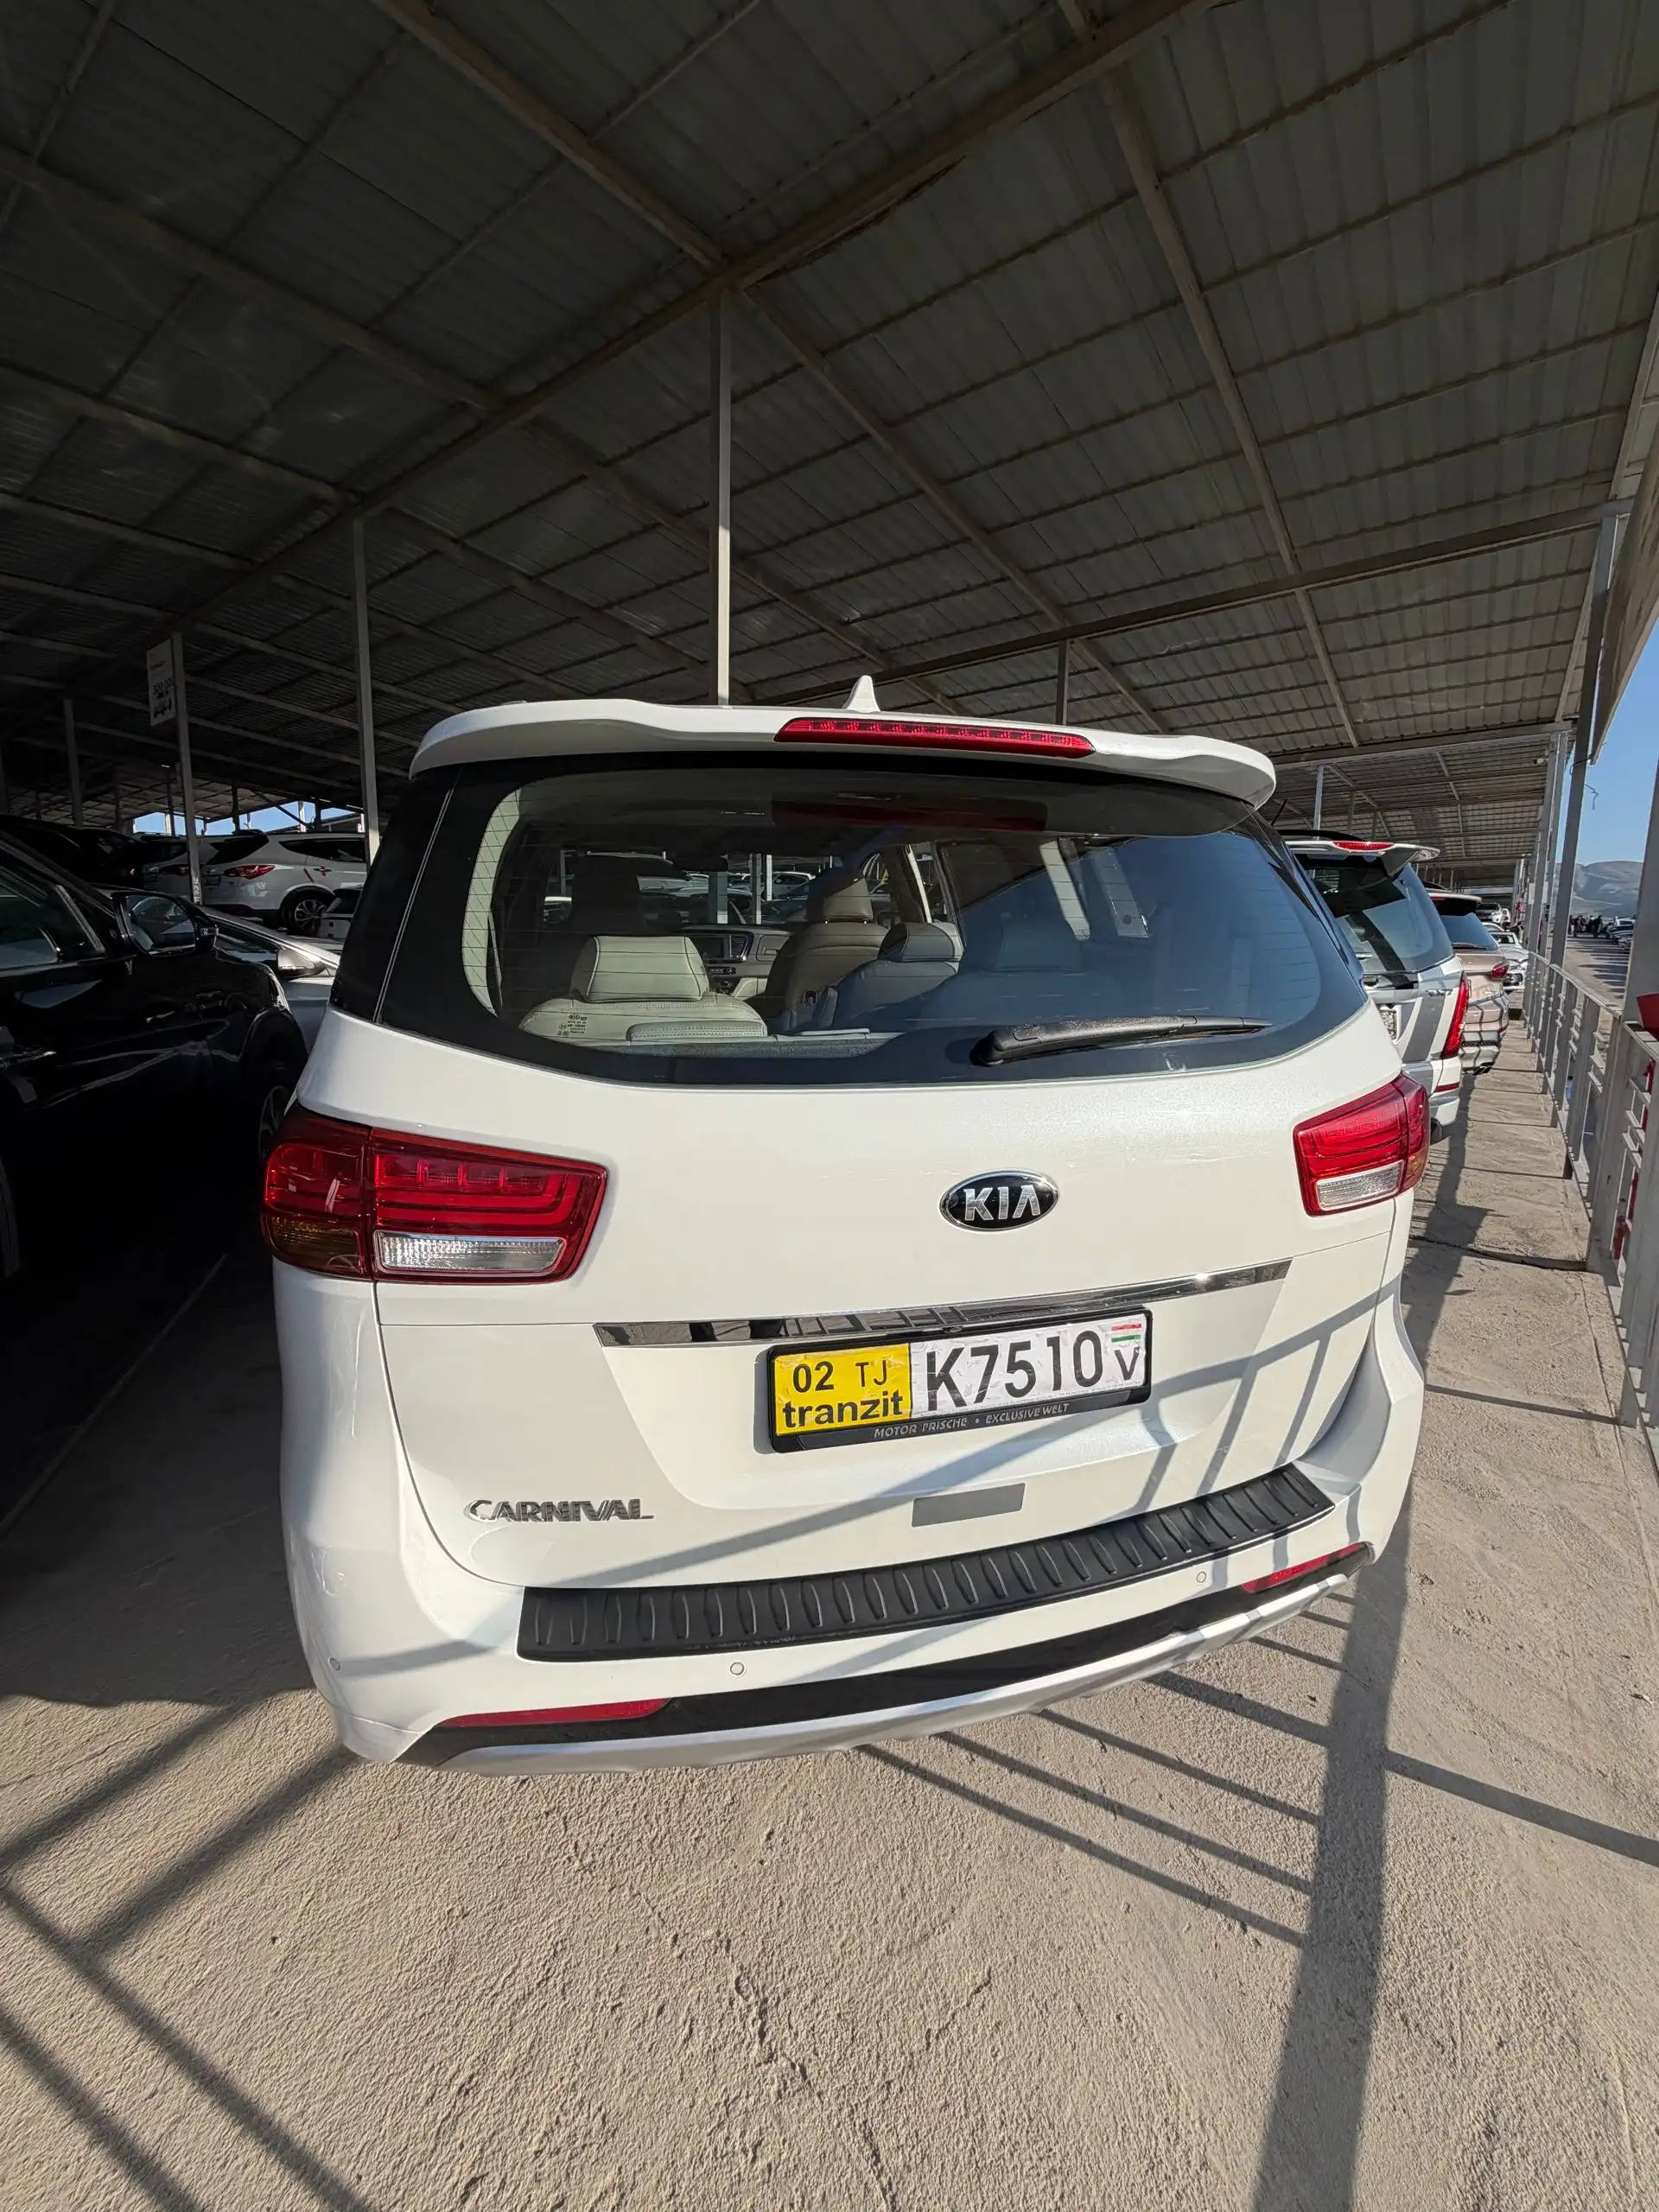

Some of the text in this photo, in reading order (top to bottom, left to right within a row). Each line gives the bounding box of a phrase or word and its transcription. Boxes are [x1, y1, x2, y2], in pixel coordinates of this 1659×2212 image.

[963, 1185, 1040, 1221] KIA
[791, 1359, 888, 1393] 02 TJ
[927, 1330, 1102, 1412] K7510
[1113, 1347, 1141, 1381] V
[782, 1391, 904, 1427] tranzit
[874, 1423, 917, 1439] MOTOR
[986, 1408, 1041, 1425] EXCLUSIVE
[1040, 1402, 1070, 1417] WELT
[463, 1497, 655, 1522] CARNIVAL
